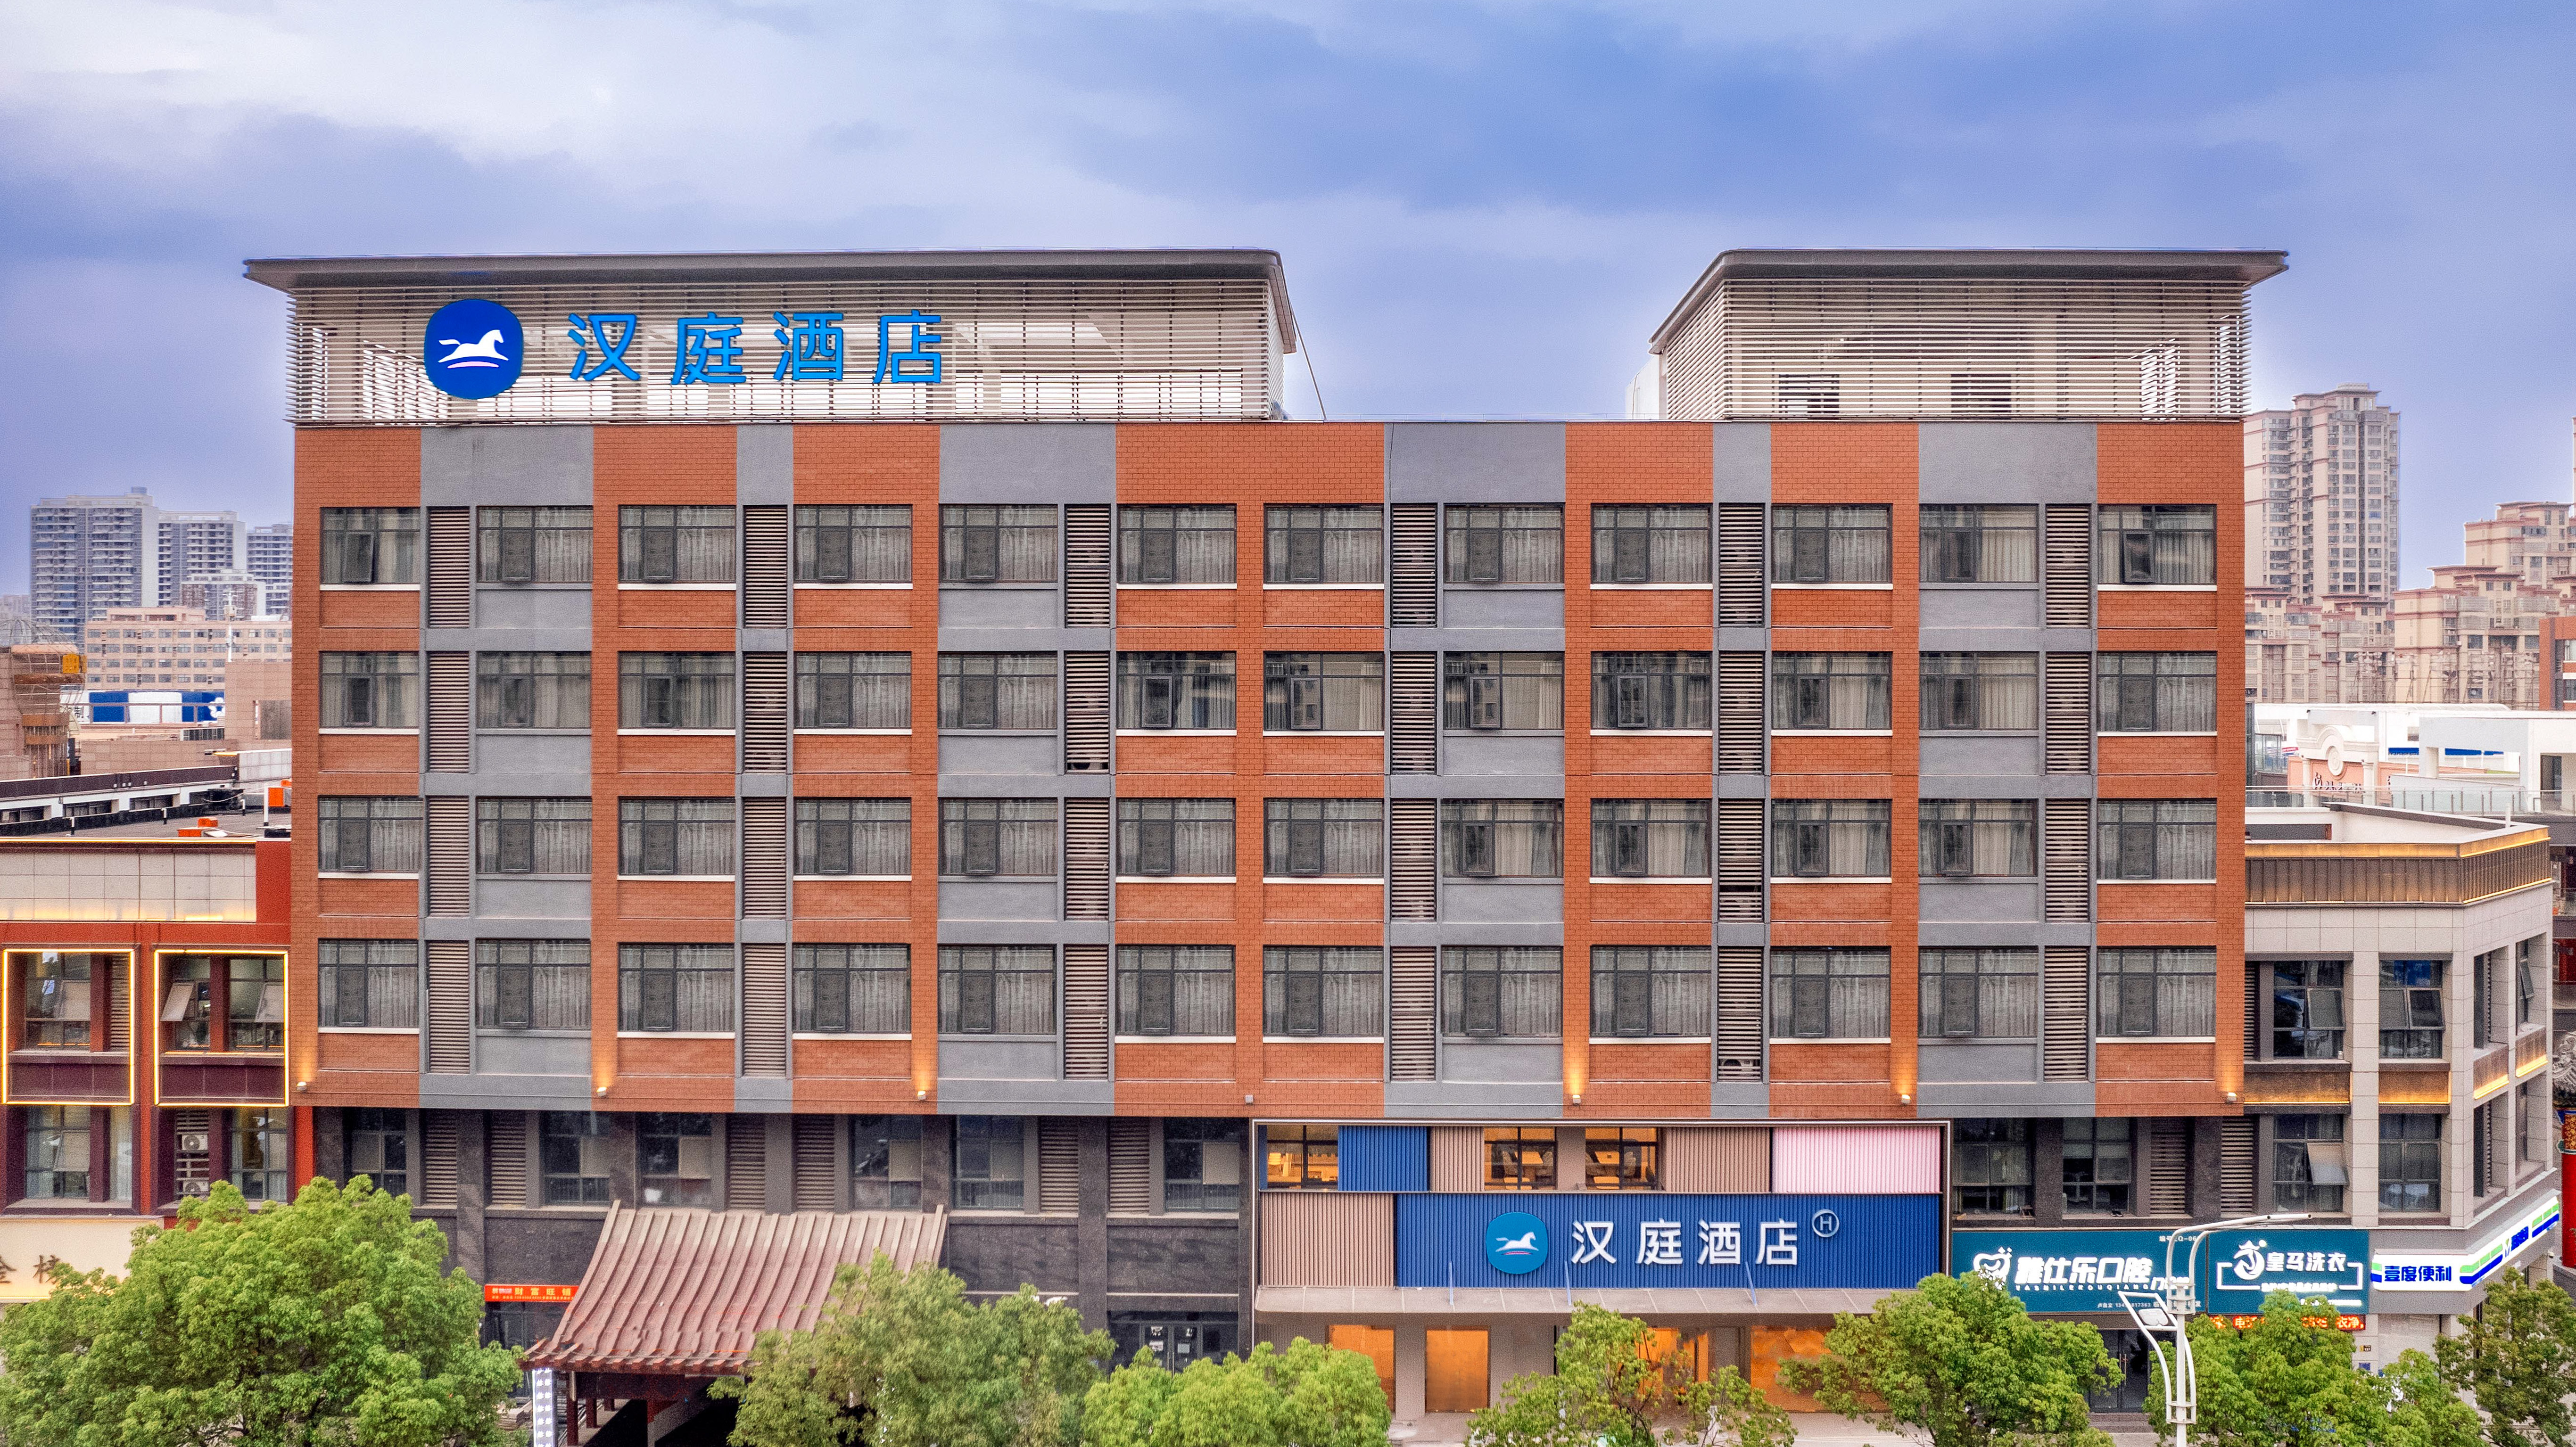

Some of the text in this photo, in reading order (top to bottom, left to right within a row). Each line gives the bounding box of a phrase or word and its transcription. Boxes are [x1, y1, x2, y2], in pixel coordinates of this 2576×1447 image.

[567, 310, 942, 385] 汉庭酒店
[1570, 1218, 1798, 1265] 汉庭酒店
[2266, 1252, 2346, 1272] 皇马洗衣
[2384, 1266, 2452, 1282] 壹度便利
